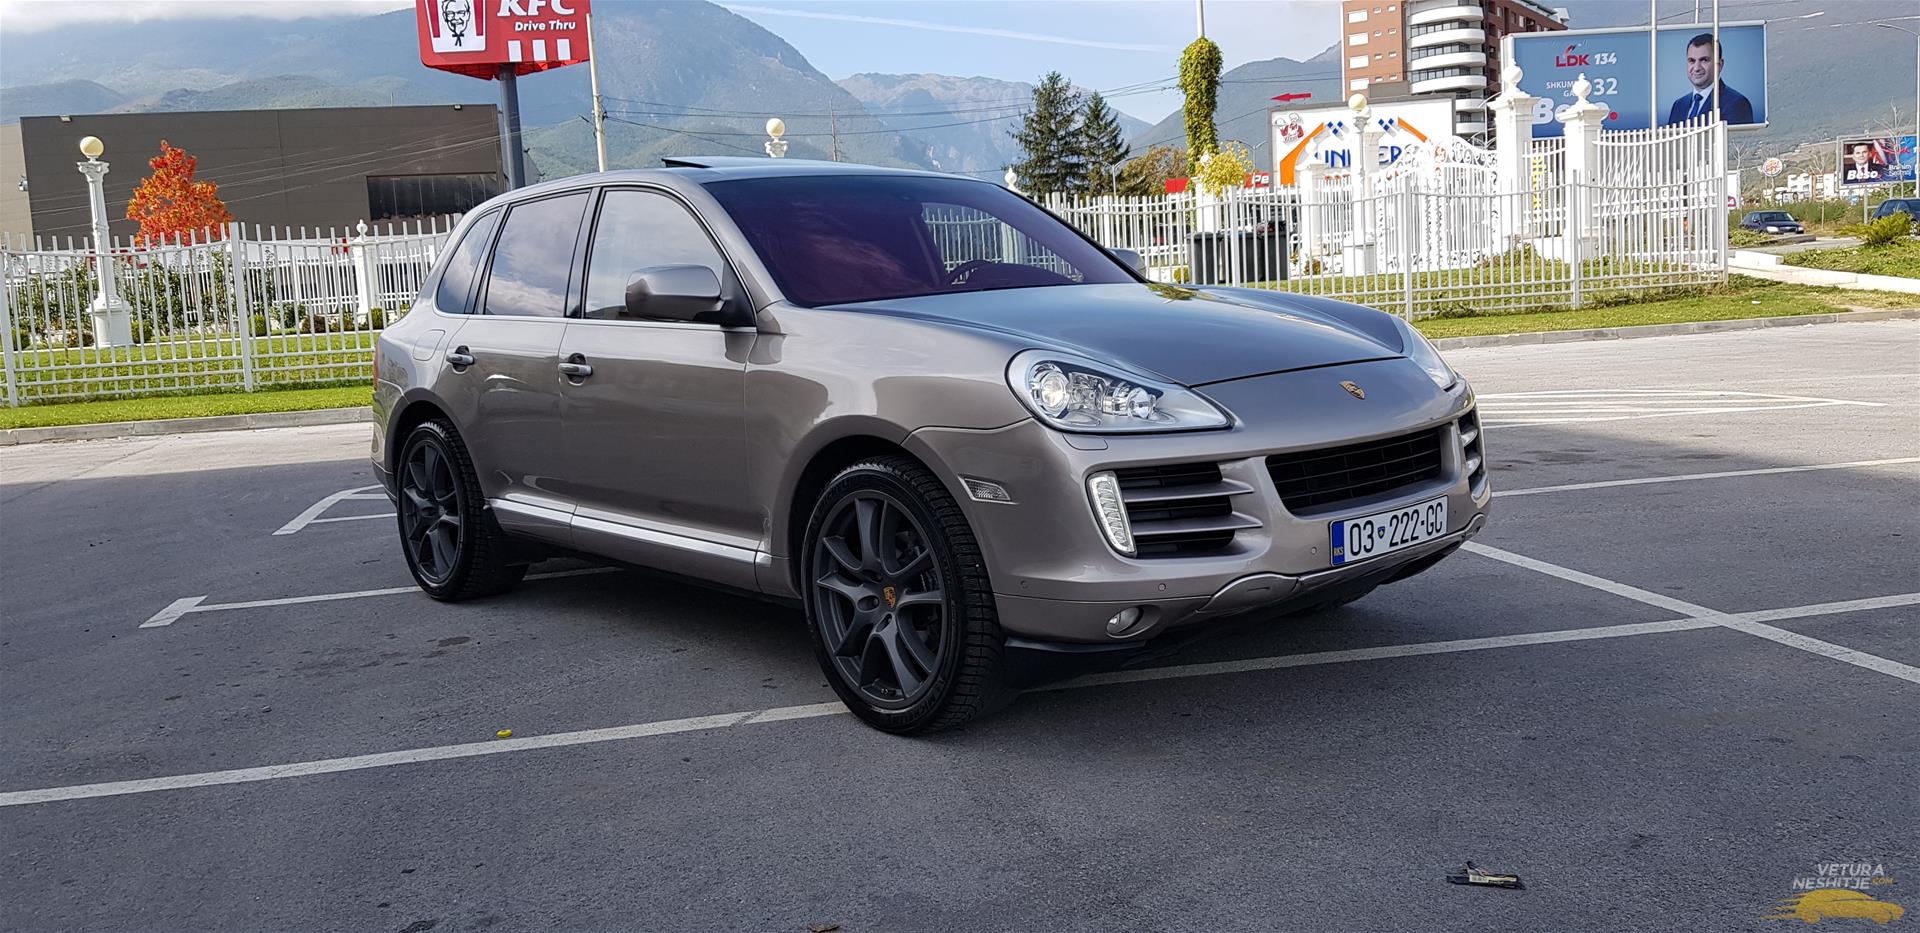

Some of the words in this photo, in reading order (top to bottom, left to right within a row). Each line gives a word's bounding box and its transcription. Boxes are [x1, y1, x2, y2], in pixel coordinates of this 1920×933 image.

[497, 0, 575, 17] KFC
[514, 20, 546, 32] Drive
[548, 20, 576, 31] Thru
[1556, 54, 1590, 67] LDK
[1594, 52, 1617, 65] 134
[1545, 80, 1575, 89] SHKUM
[1593, 78, 1618, 96] 32
[1349, 520, 1375, 557] 03
